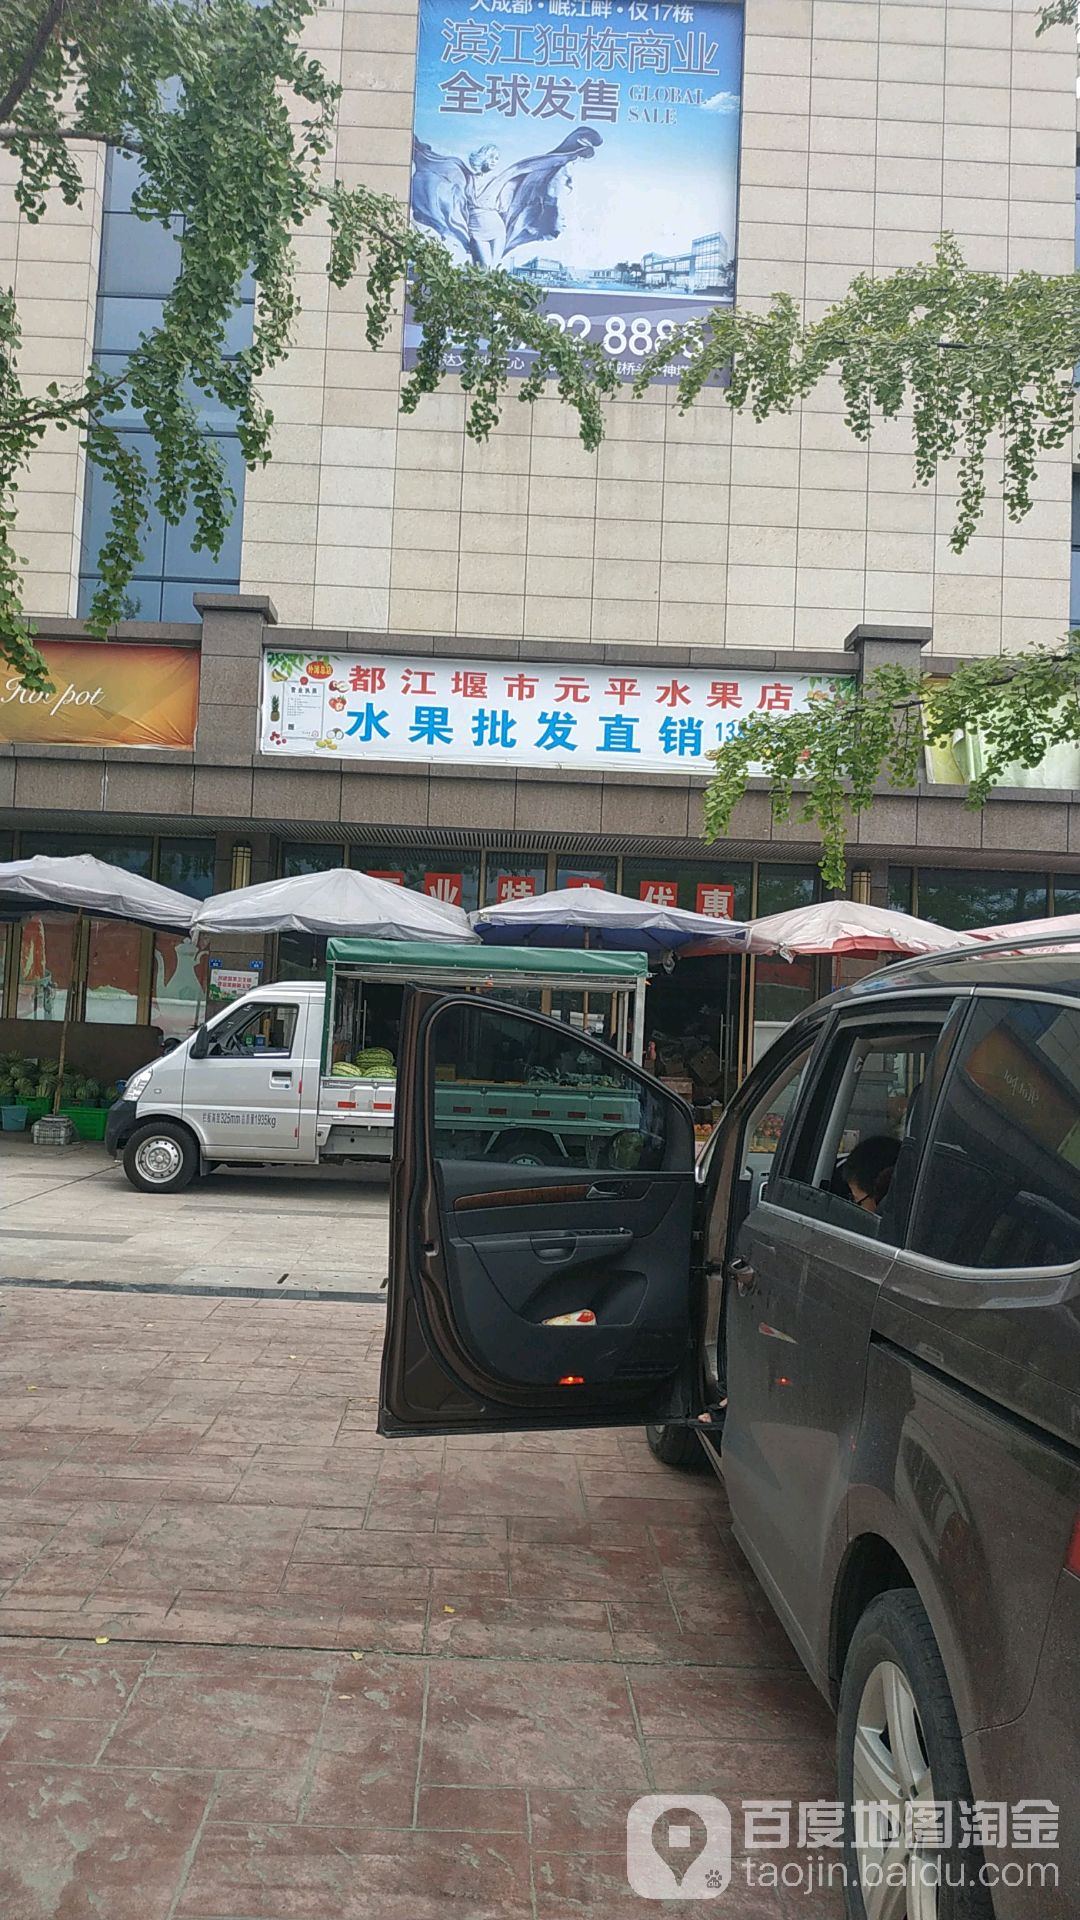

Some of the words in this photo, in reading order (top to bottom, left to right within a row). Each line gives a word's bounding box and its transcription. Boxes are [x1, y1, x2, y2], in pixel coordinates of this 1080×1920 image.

[440, 18, 720, 76] 滨江独栋商业
[438, 70, 620, 123] 全球发售
[628, 107, 677, 124] SALE
[629, 85, 706, 105] GLOBAL
[50, 684, 106, 716] pot
[349, 665, 793, 711] 都江堰市元平水果店
[345, 702, 704, 756] 水果批发直销
